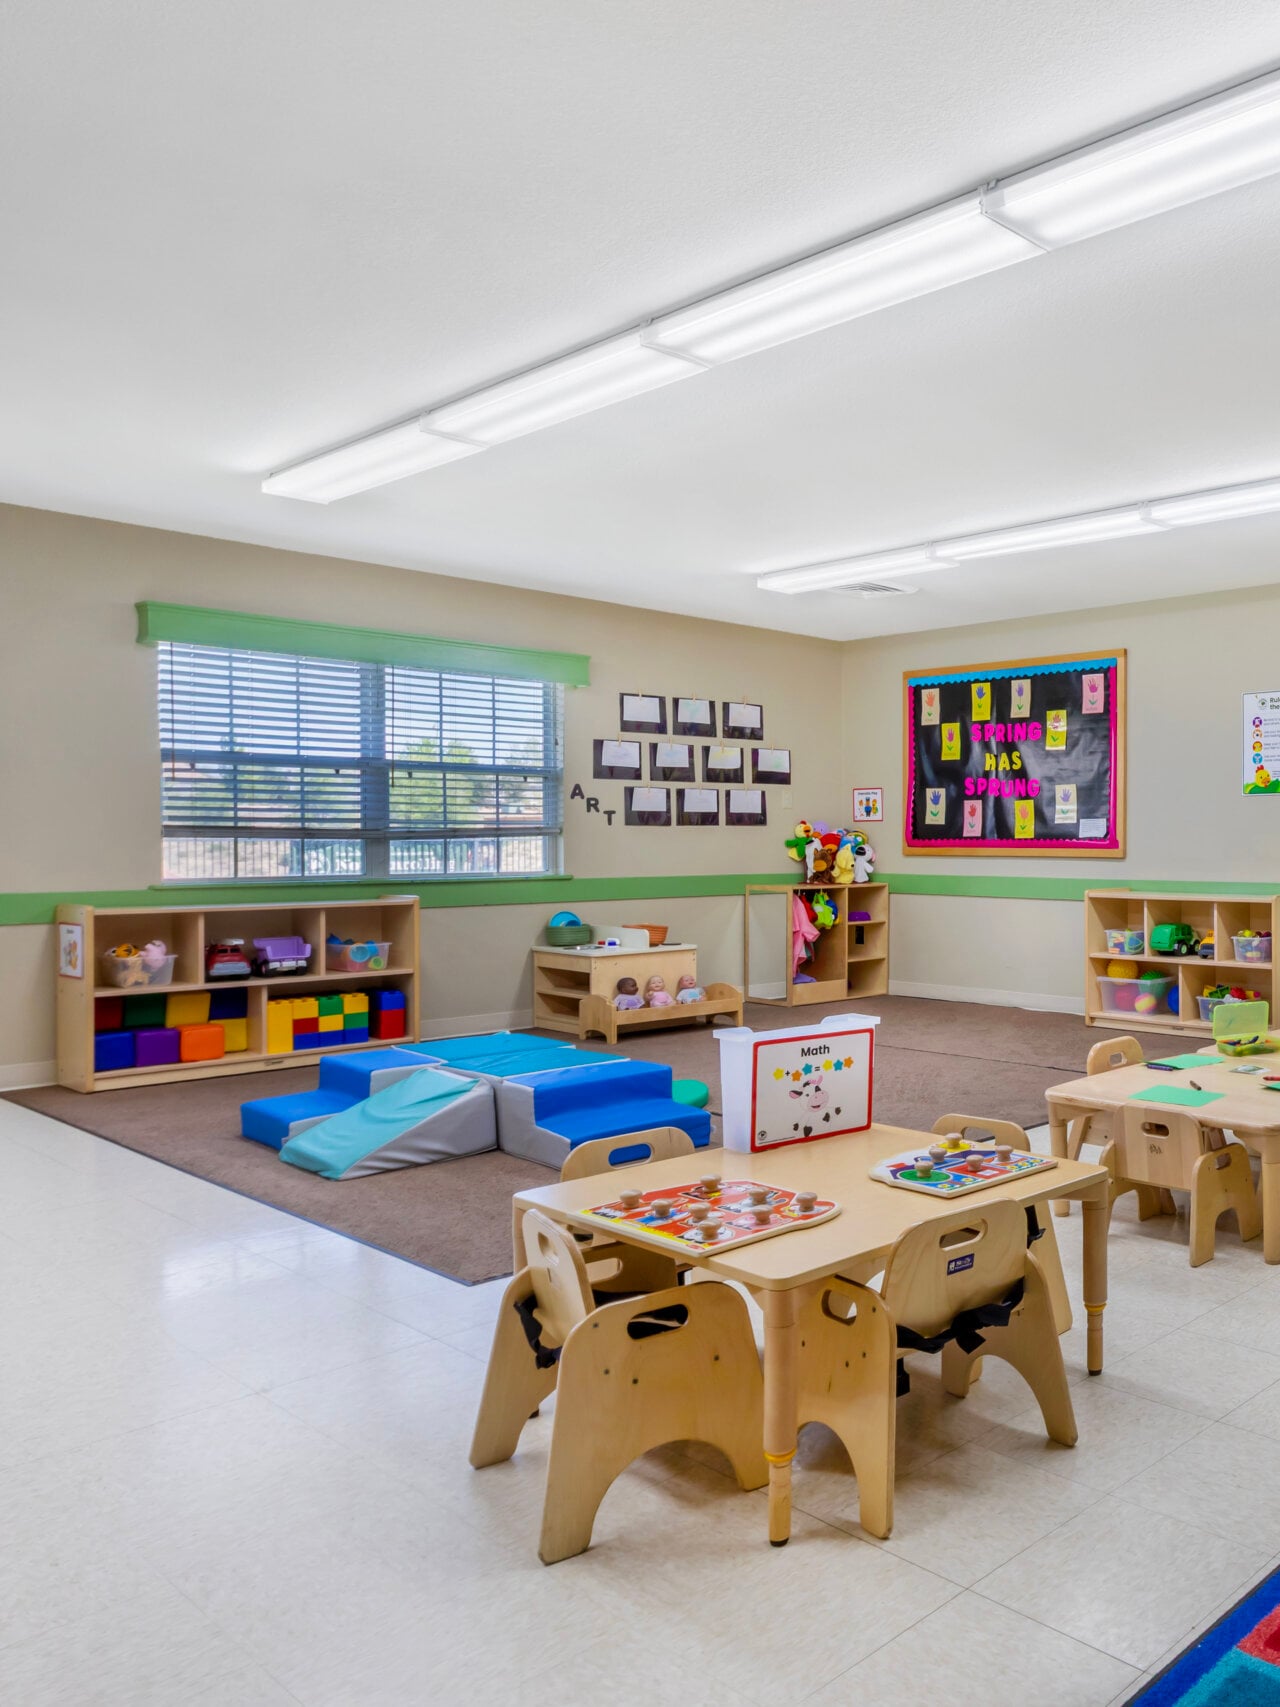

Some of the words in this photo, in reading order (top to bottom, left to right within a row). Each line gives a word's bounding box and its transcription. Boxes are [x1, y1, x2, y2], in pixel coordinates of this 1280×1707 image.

[971, 721, 1042, 743] SPRING
[984, 751, 1022, 771] HAS
[964, 777, 1041, 799] SPRUNG
[571, 783, 616, 826] ART
[800, 1045, 830, 1057] Math
